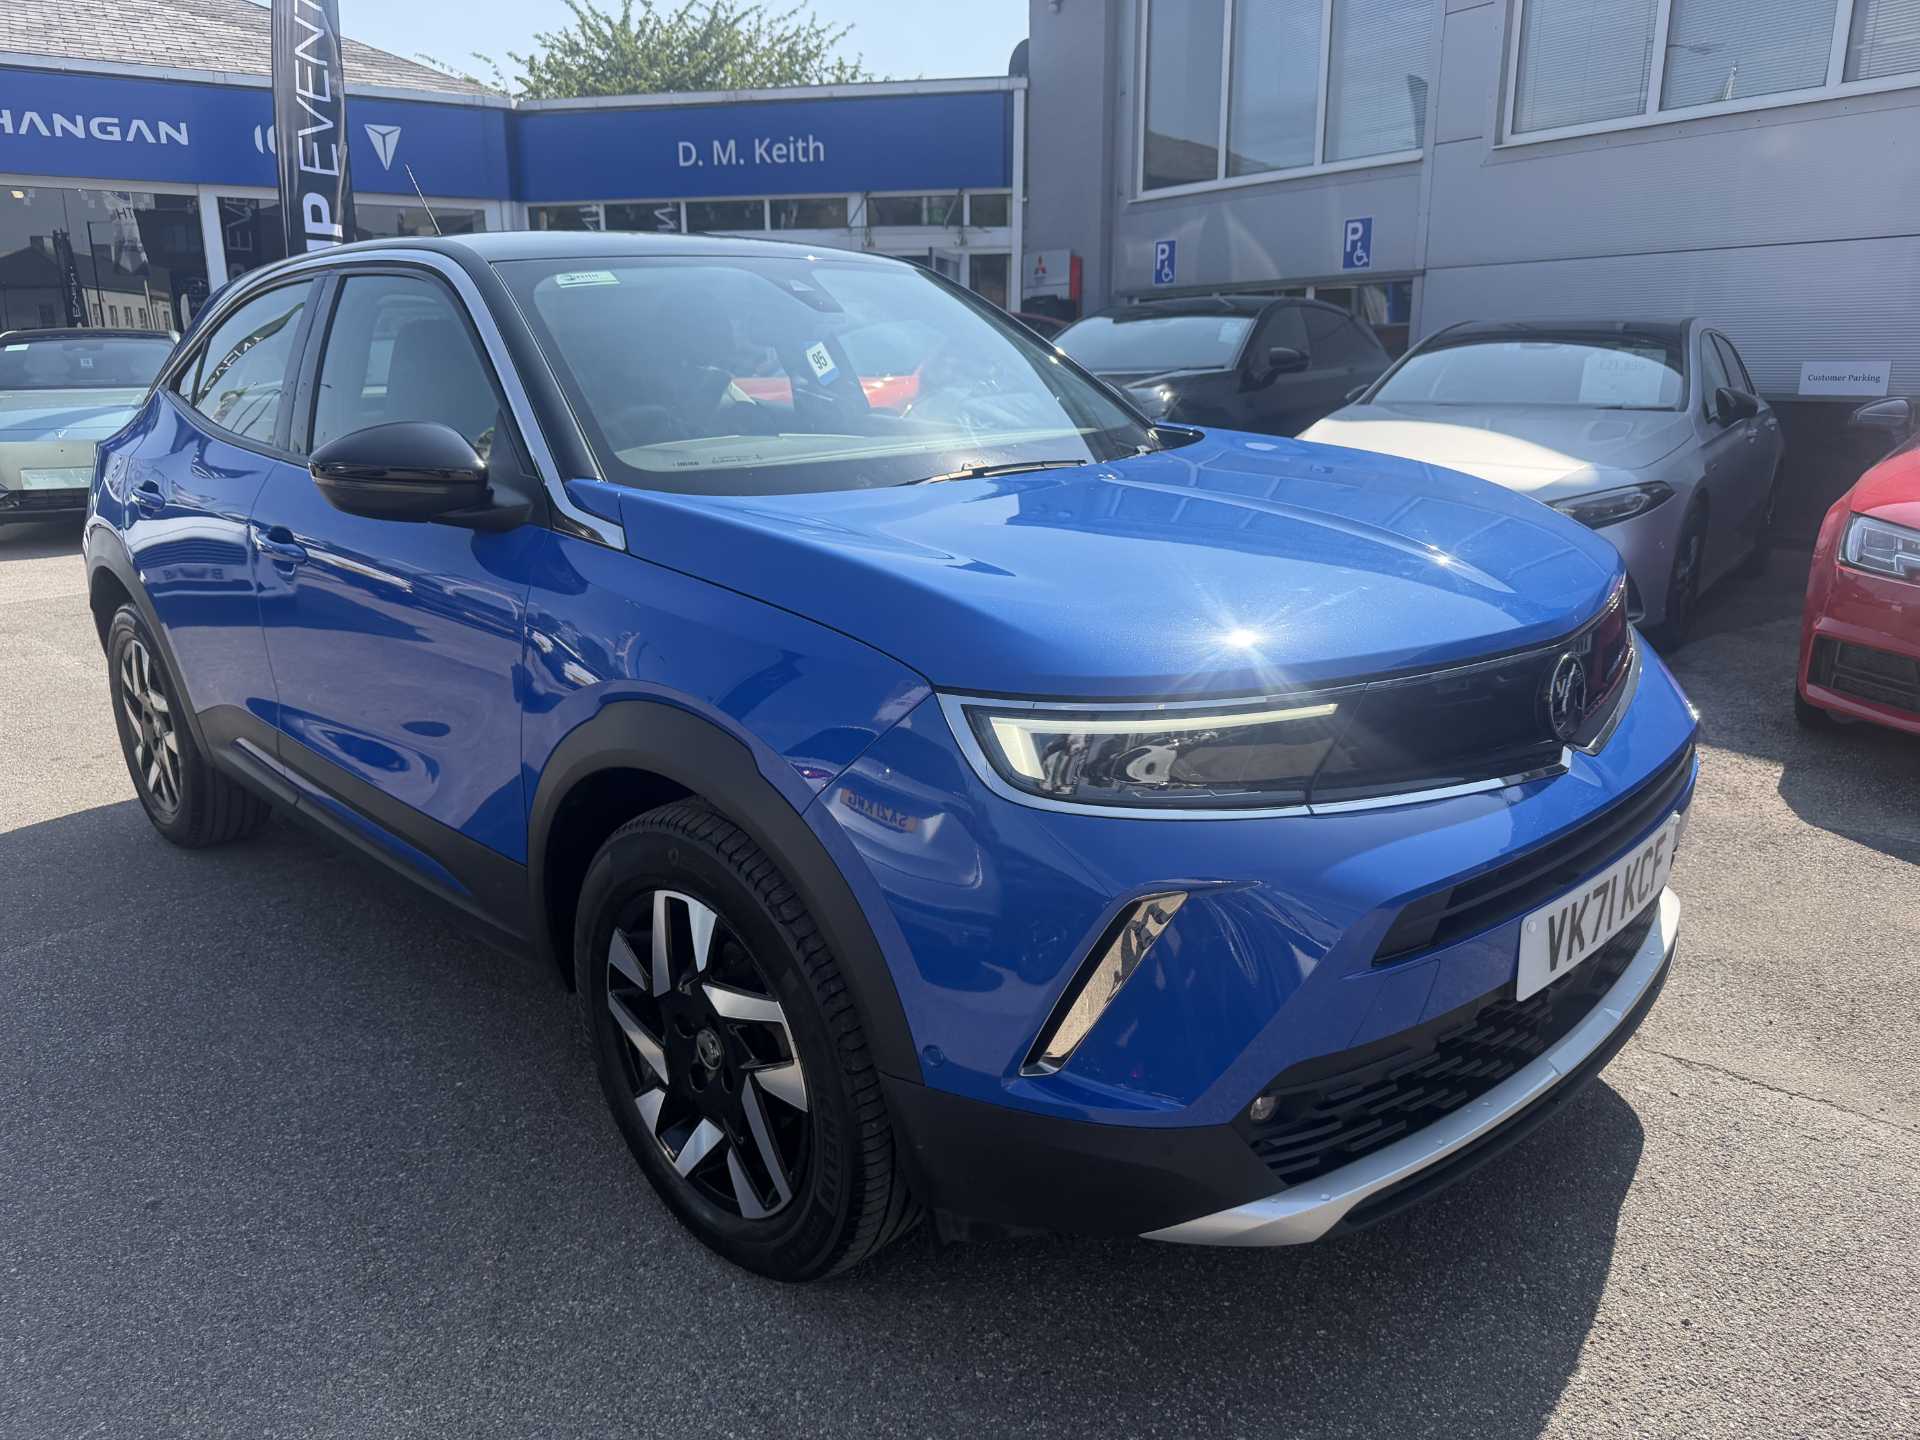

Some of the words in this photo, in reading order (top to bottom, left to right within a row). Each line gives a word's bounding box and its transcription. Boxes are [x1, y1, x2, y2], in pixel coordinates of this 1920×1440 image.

[677, 141, 703, 167] D.
[712, 139, 745, 166] M.
[754, 134, 825, 164] Keith
[1346, 222, 1363, 252] P
[1156, 244, 1169, 270] P
[811, 350, 828, 370] 95
[1807, 373, 1847, 382] Customer
[1848, 372, 1881, 384] Parking
[1547, 874, 1618, 973] VK71
[1619, 831, 1667, 921] KCF
